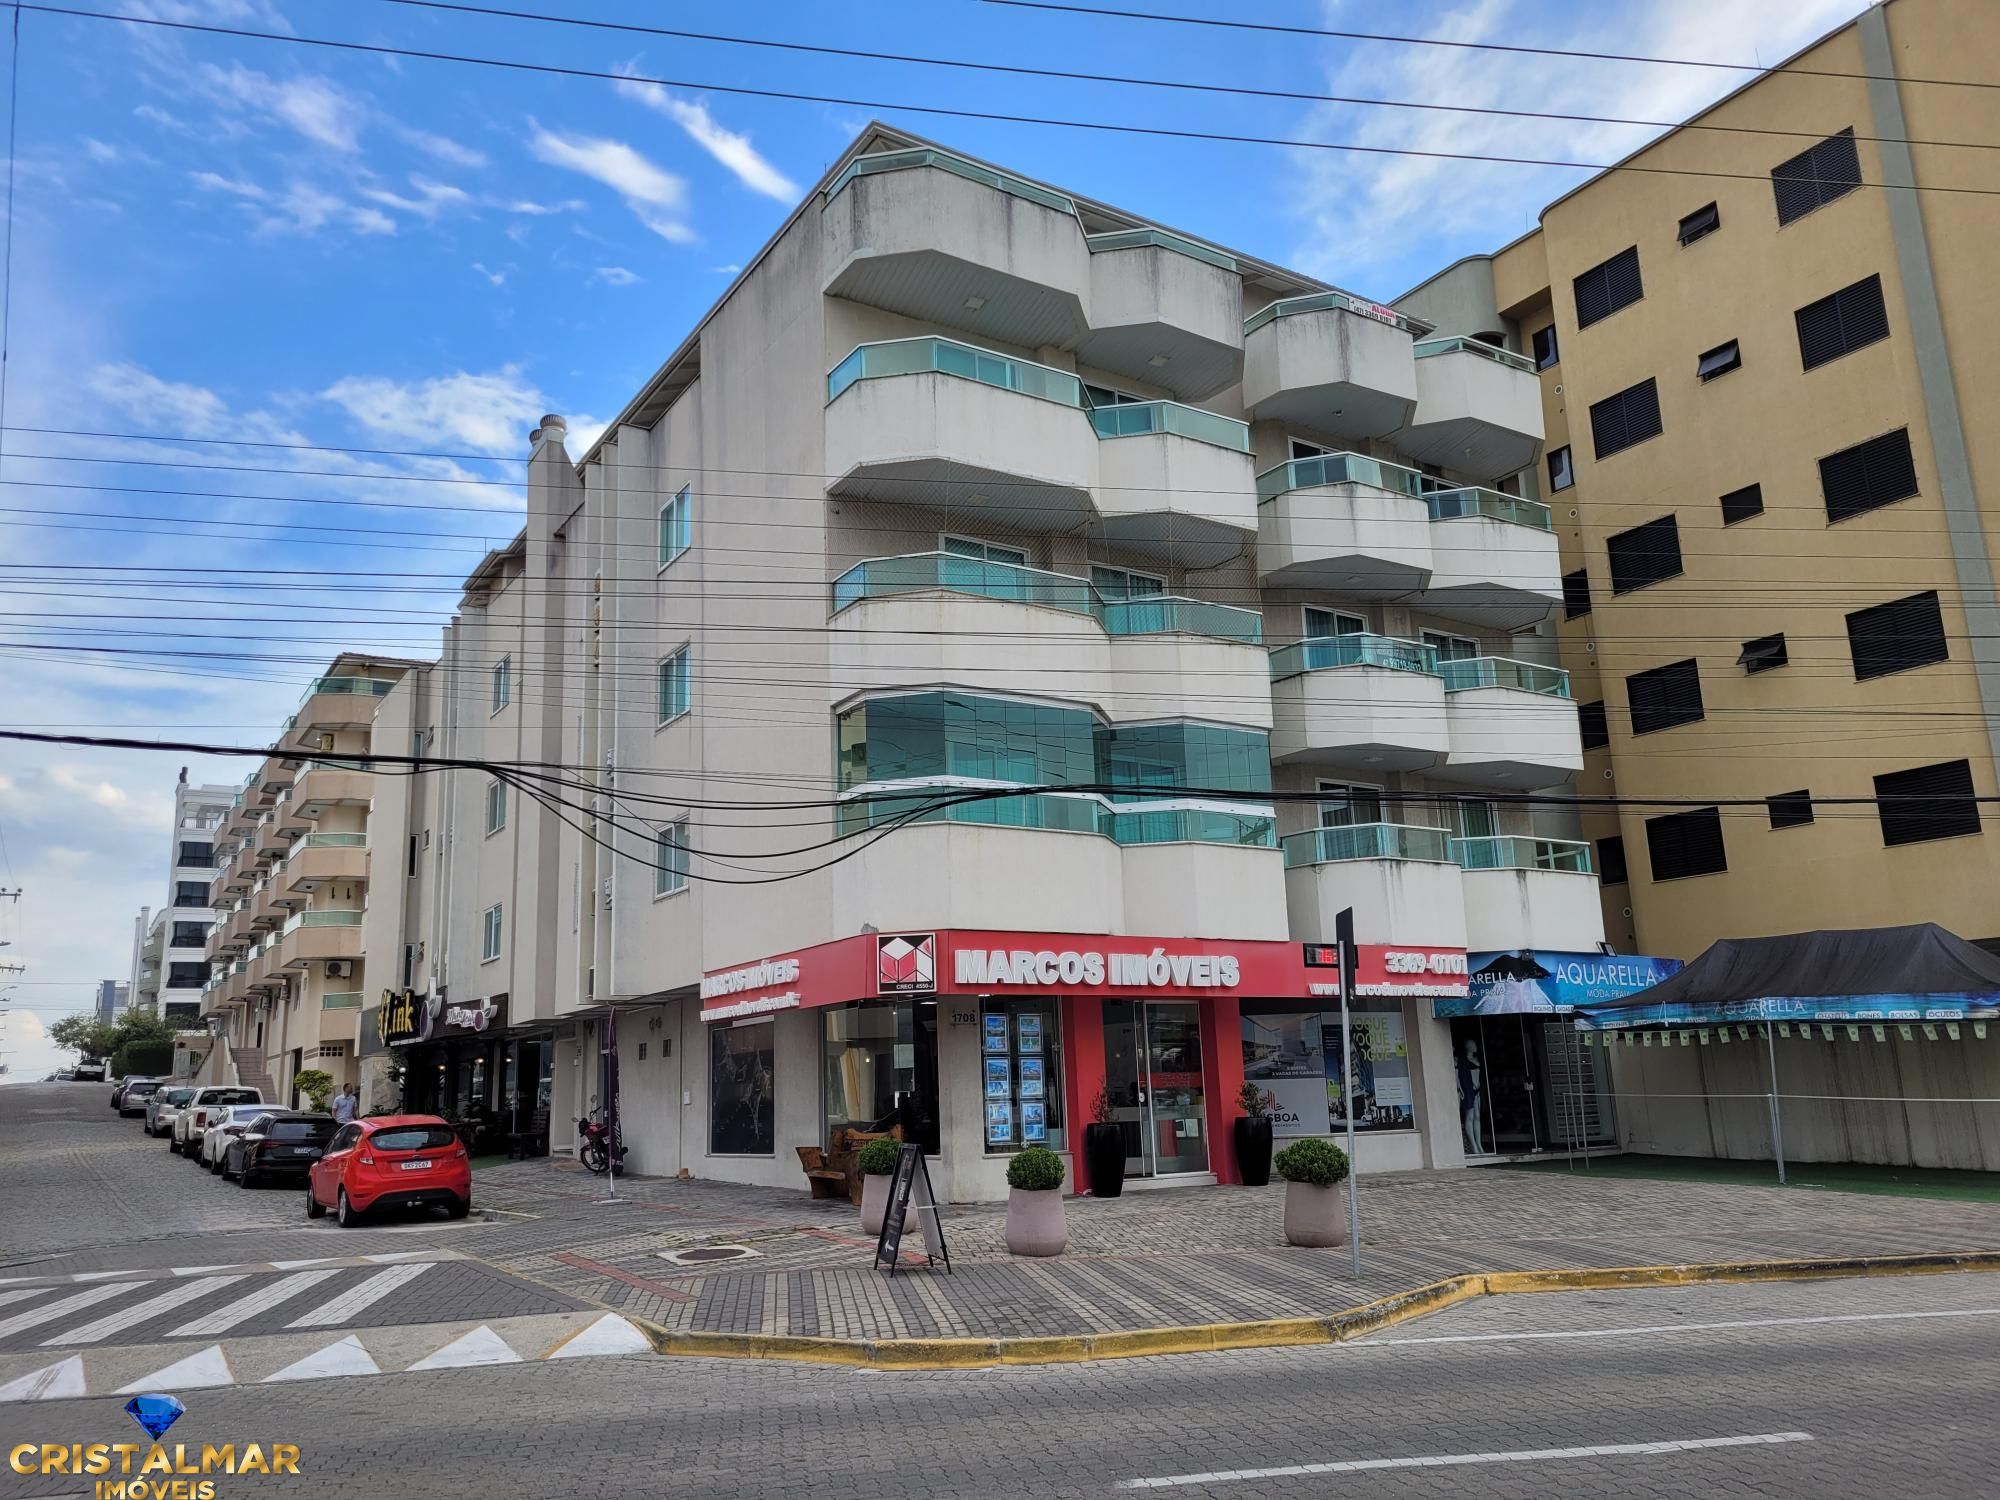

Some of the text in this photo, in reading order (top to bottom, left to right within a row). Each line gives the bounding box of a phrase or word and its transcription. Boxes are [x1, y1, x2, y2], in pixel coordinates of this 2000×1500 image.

[954, 948, 1241, 987] MARCOS IMÓVEIS
[1555, 963, 1658, 987] AQUARELLA
[699, 958, 800, 999] MARCOS IMÓVEIS
[1467, 971, 1516, 985] ARELLA
[1586, 989, 1610, 998] MODA
[1714, 998, 1806, 1016] AQUARELLA
[952, 1013, 976, 1023] 1708
